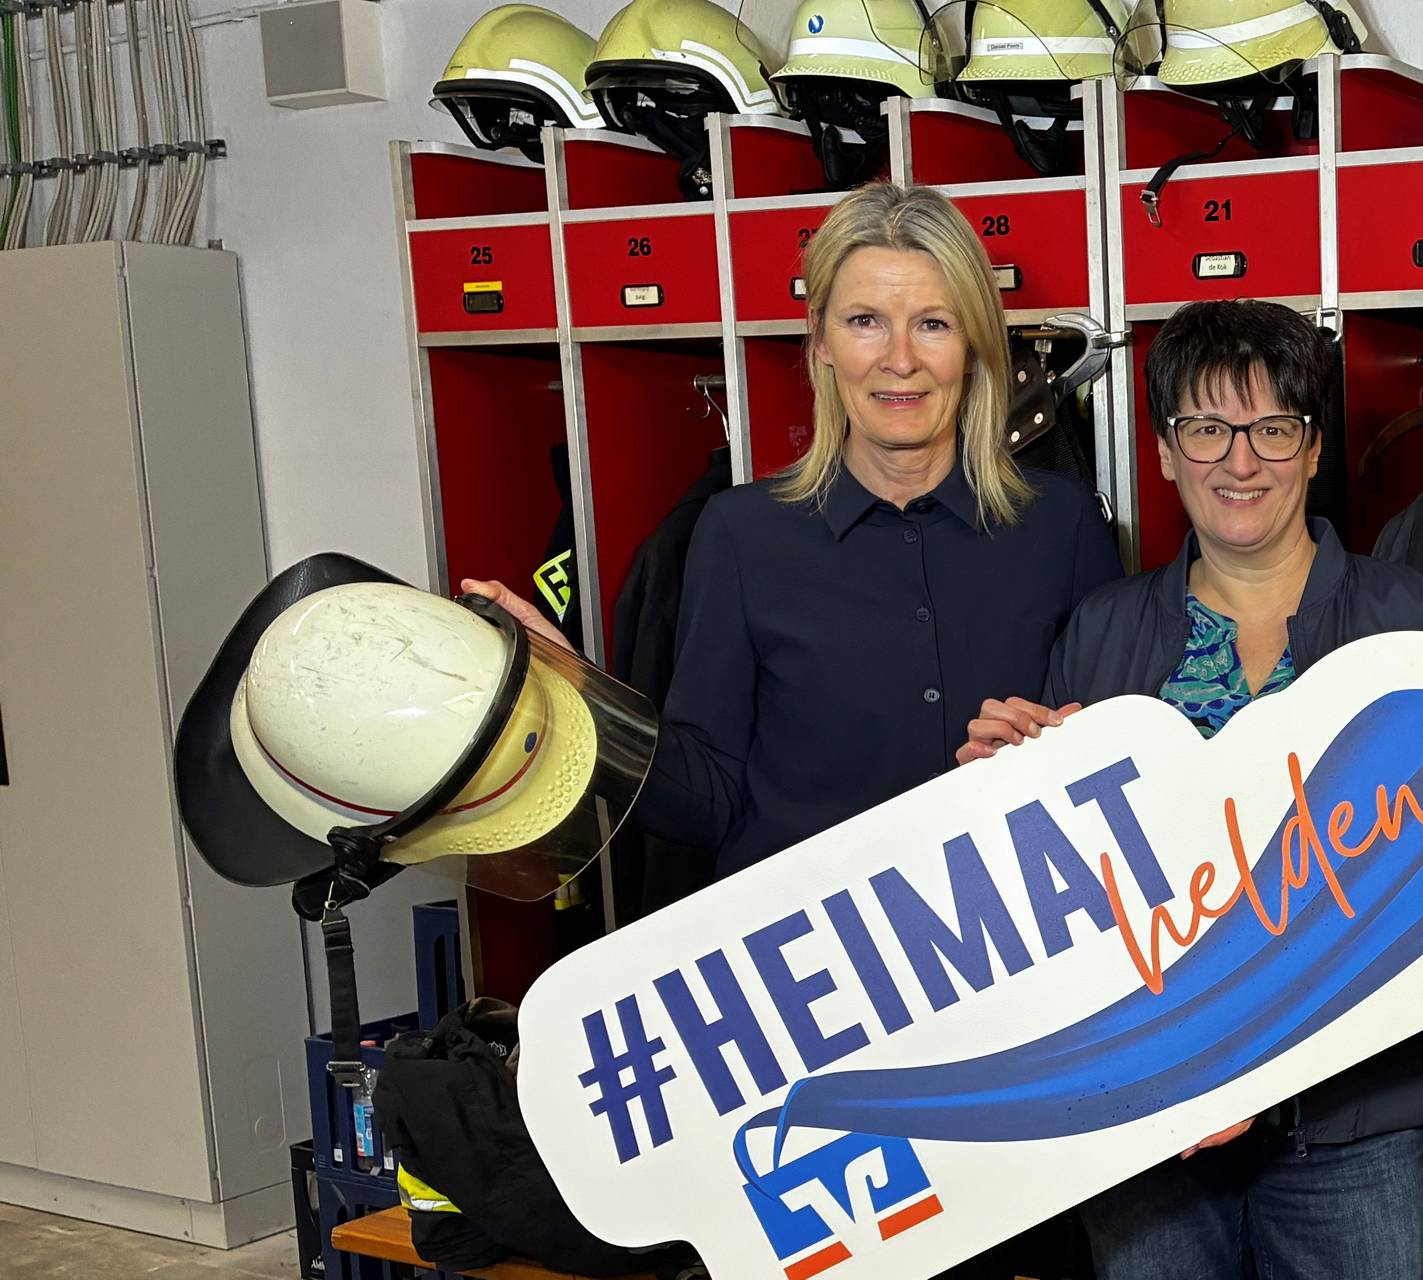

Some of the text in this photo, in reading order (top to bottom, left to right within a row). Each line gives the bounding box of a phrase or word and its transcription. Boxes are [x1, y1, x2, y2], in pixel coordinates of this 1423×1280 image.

[1204, 199, 1232, 222] 21
[982, 216, 1010, 236] 28
[470, 246, 493, 264] 25
[627, 237, 652, 257] 26
[578, 756, 1175, 1164] #HEIMAT
